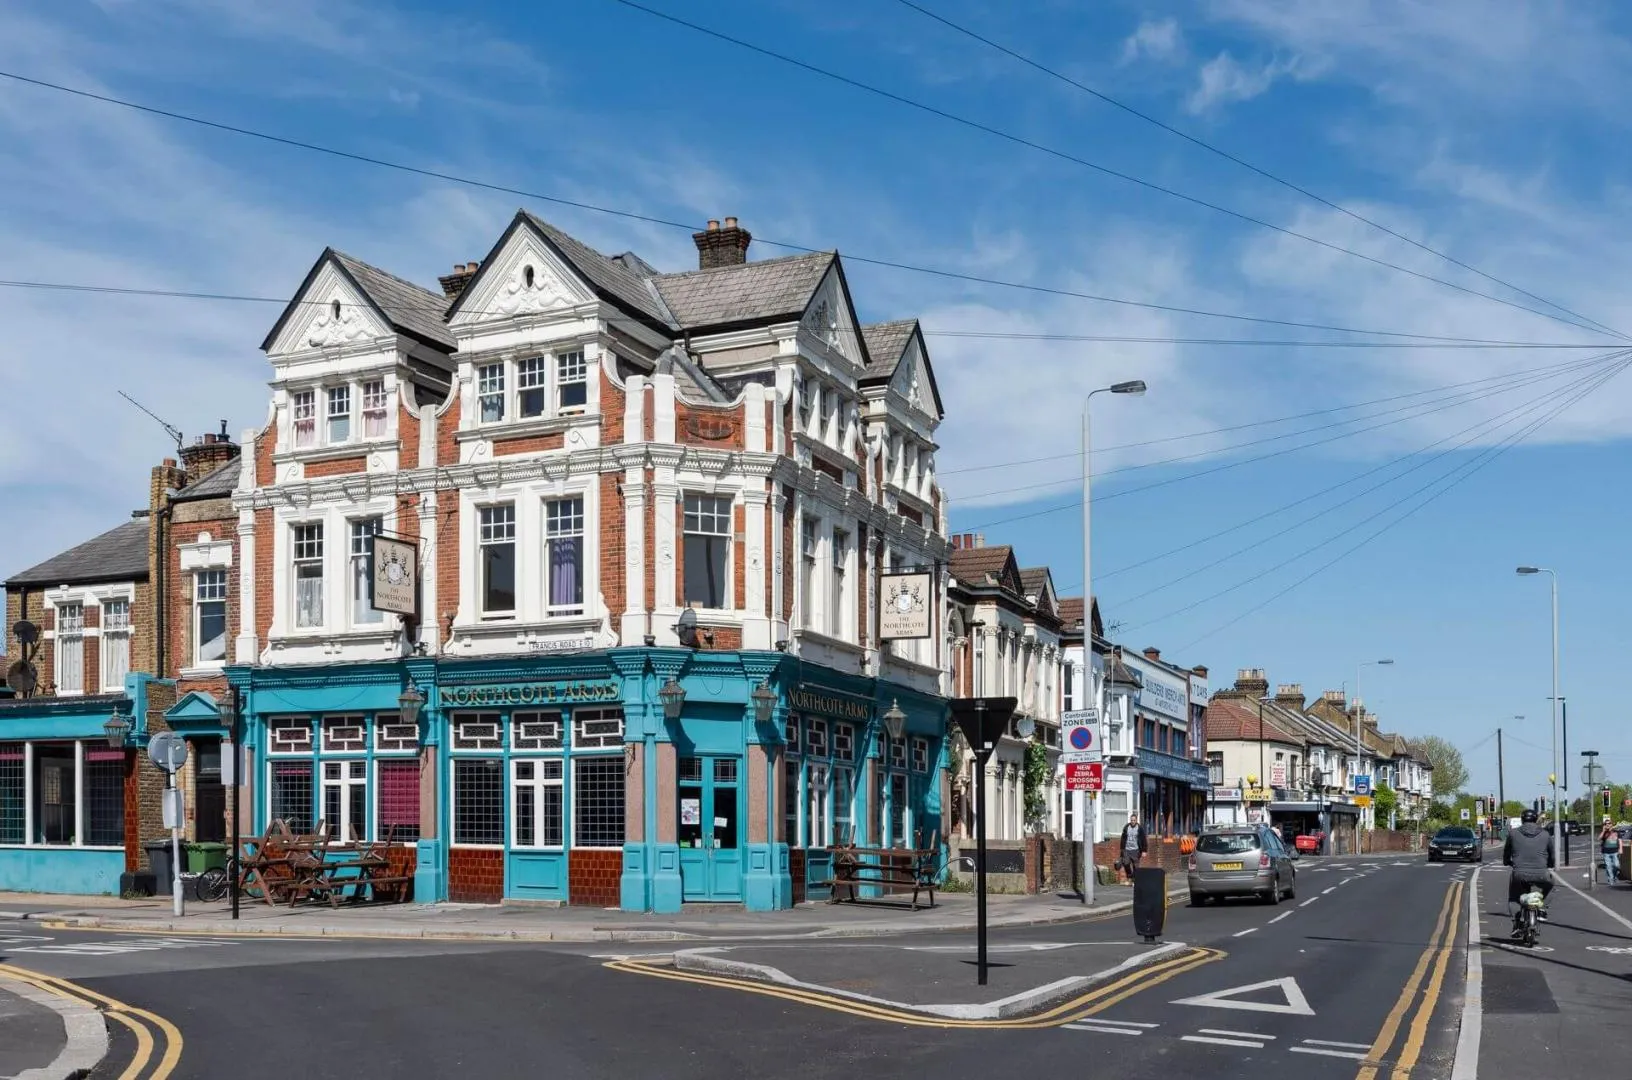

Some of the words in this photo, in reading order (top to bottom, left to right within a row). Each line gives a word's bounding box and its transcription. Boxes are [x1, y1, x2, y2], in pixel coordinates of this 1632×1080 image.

[440, 686, 556, 706] NORTHCOTE
[564, 681, 619, 701] ARMS
[788, 687, 843, 714] NORTHCOTE
[845, 701, 868, 719] ARMS
[1063, 718, 1085, 727] ZONE
[1064, 711, 1095, 719] Controlled
